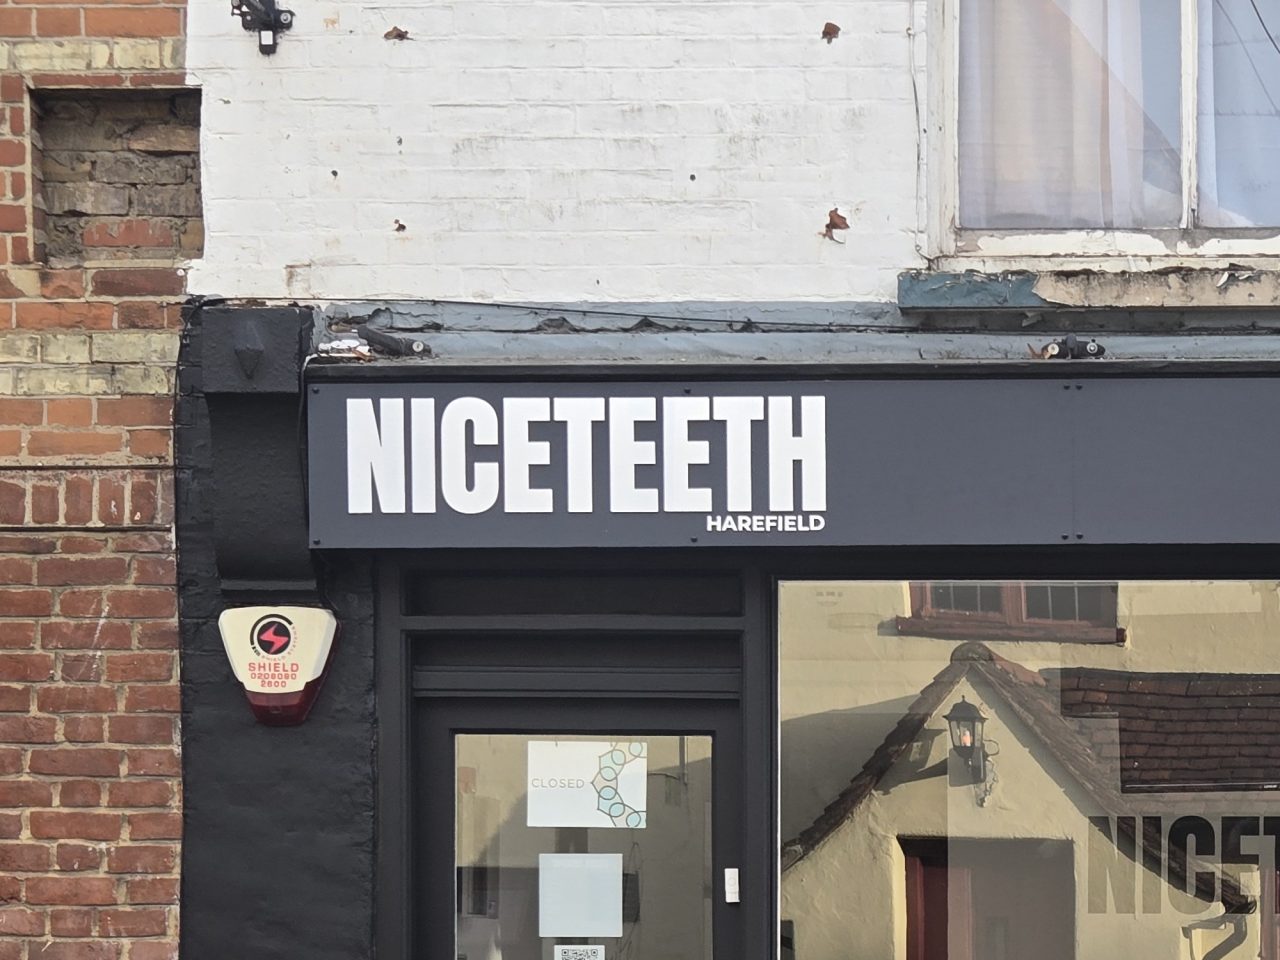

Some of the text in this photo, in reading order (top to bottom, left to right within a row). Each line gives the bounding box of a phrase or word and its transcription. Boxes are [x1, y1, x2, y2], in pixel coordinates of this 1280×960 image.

[346, 395, 827, 514] NICETEETH
[706, 514, 826, 532] HAREFIELD
[248, 662, 299, 672] SHIELD
[531, 778, 585, 789] CLOSED
